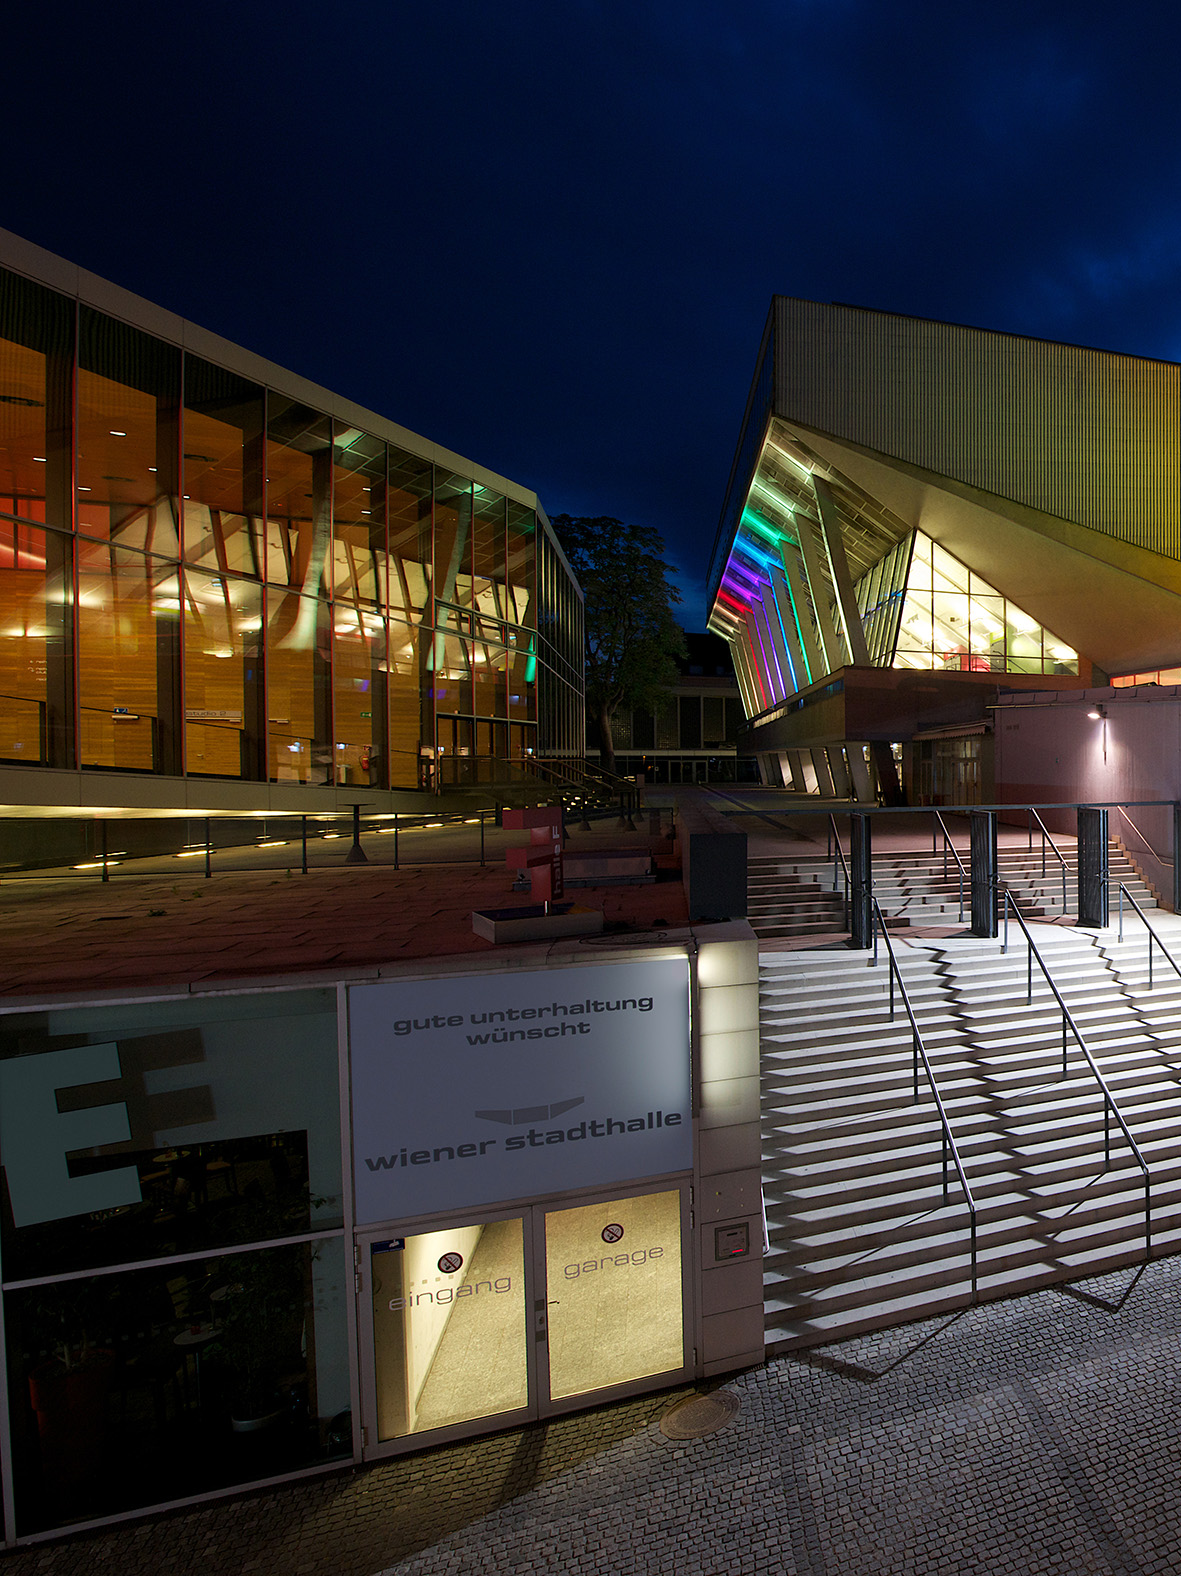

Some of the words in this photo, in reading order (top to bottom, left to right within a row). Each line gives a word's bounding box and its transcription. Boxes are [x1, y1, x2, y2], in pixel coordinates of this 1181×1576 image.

[393, 1015, 464, 1037] gute
[470, 997, 654, 1025] unterhaltung
[465, 1021, 592, 1046] wünscht
[364, 1139, 497, 1172] wiener
[504, 1110, 683, 1152] stadthalle
[563, 1246, 664, 1280] garage
[388, 1277, 512, 1311] eingang
